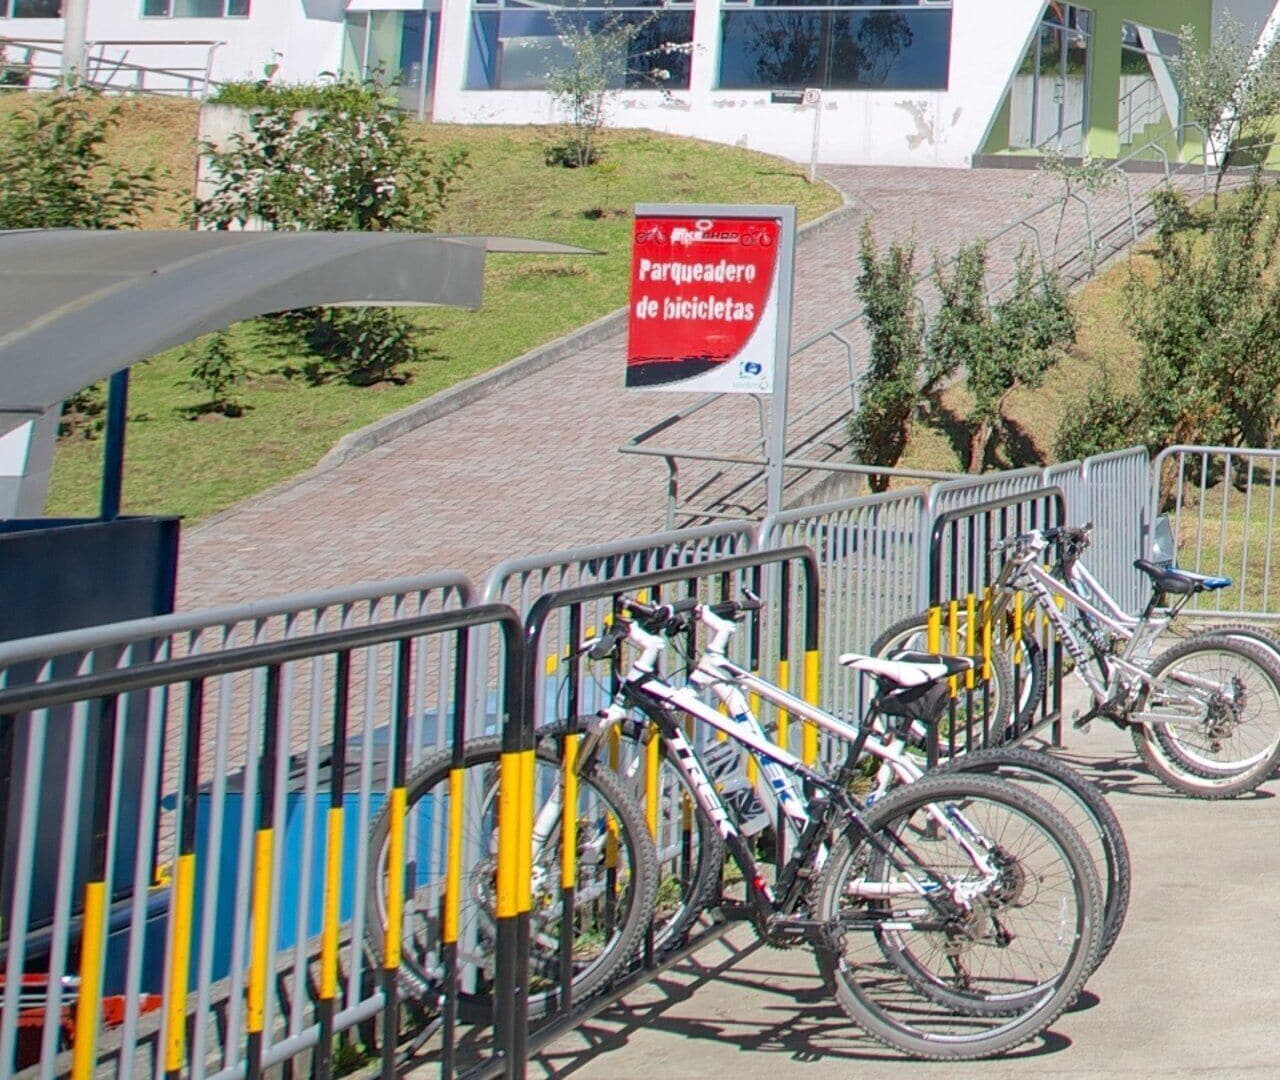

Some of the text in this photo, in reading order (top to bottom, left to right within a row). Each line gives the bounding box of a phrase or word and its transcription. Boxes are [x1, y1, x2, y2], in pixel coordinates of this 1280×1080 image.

[639, 258, 756, 286] Parqueadero
[636, 295, 754, 321] de bicicletas
[665, 728, 738, 840] TREK
